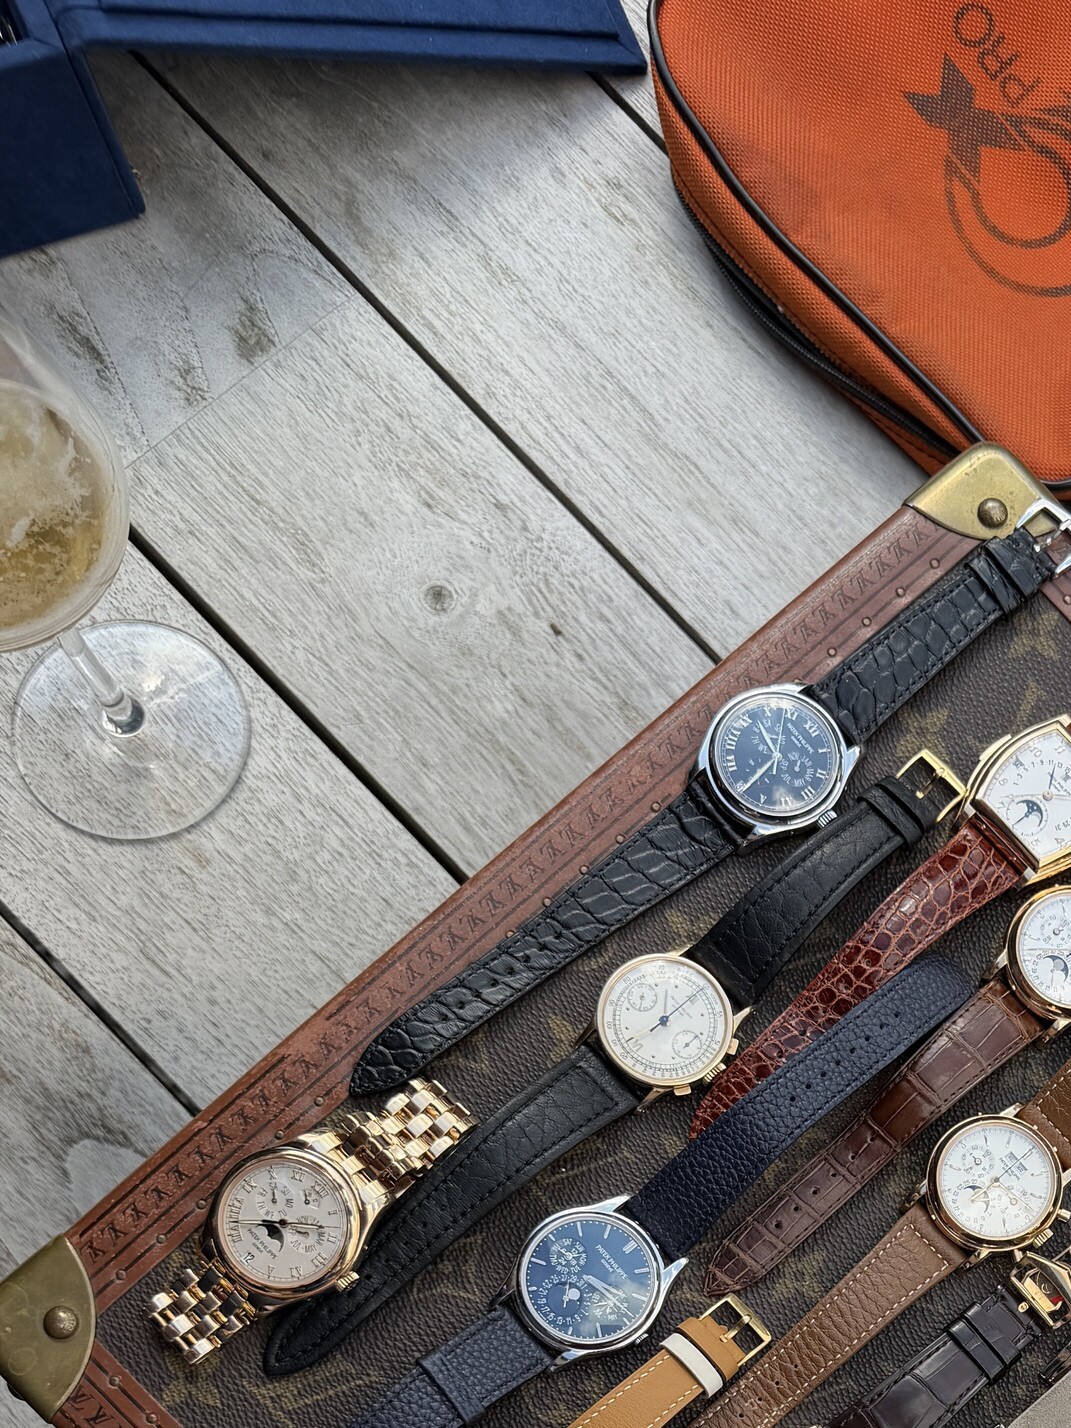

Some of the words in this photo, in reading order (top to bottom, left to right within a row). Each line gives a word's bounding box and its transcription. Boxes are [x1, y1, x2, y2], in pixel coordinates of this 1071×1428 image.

[953, 2, 1041, 109] PRO
[785, 707, 799, 721] XI
[803, 719, 821, 737] XII
[1028, 747, 1042, 758] 10
[1054, 745, 1067, 754] 11
[817, 769, 826, 779] II
[801, 786, 815, 800] III
[291, 1170, 305, 1182] XI
[285, 1198, 294, 1208] MO
[245, 1227, 261, 1243] PATEK
[257, 1239, 278, 1260] PHILIPPE
[327, 1233, 338, 1244] II
[243, 1252, 255, 1264] 12
[311, 1253, 327, 1268] III
[594, 1244, 610, 1260] PATEK
[606, 1257, 628, 1279] PHILIPPE
